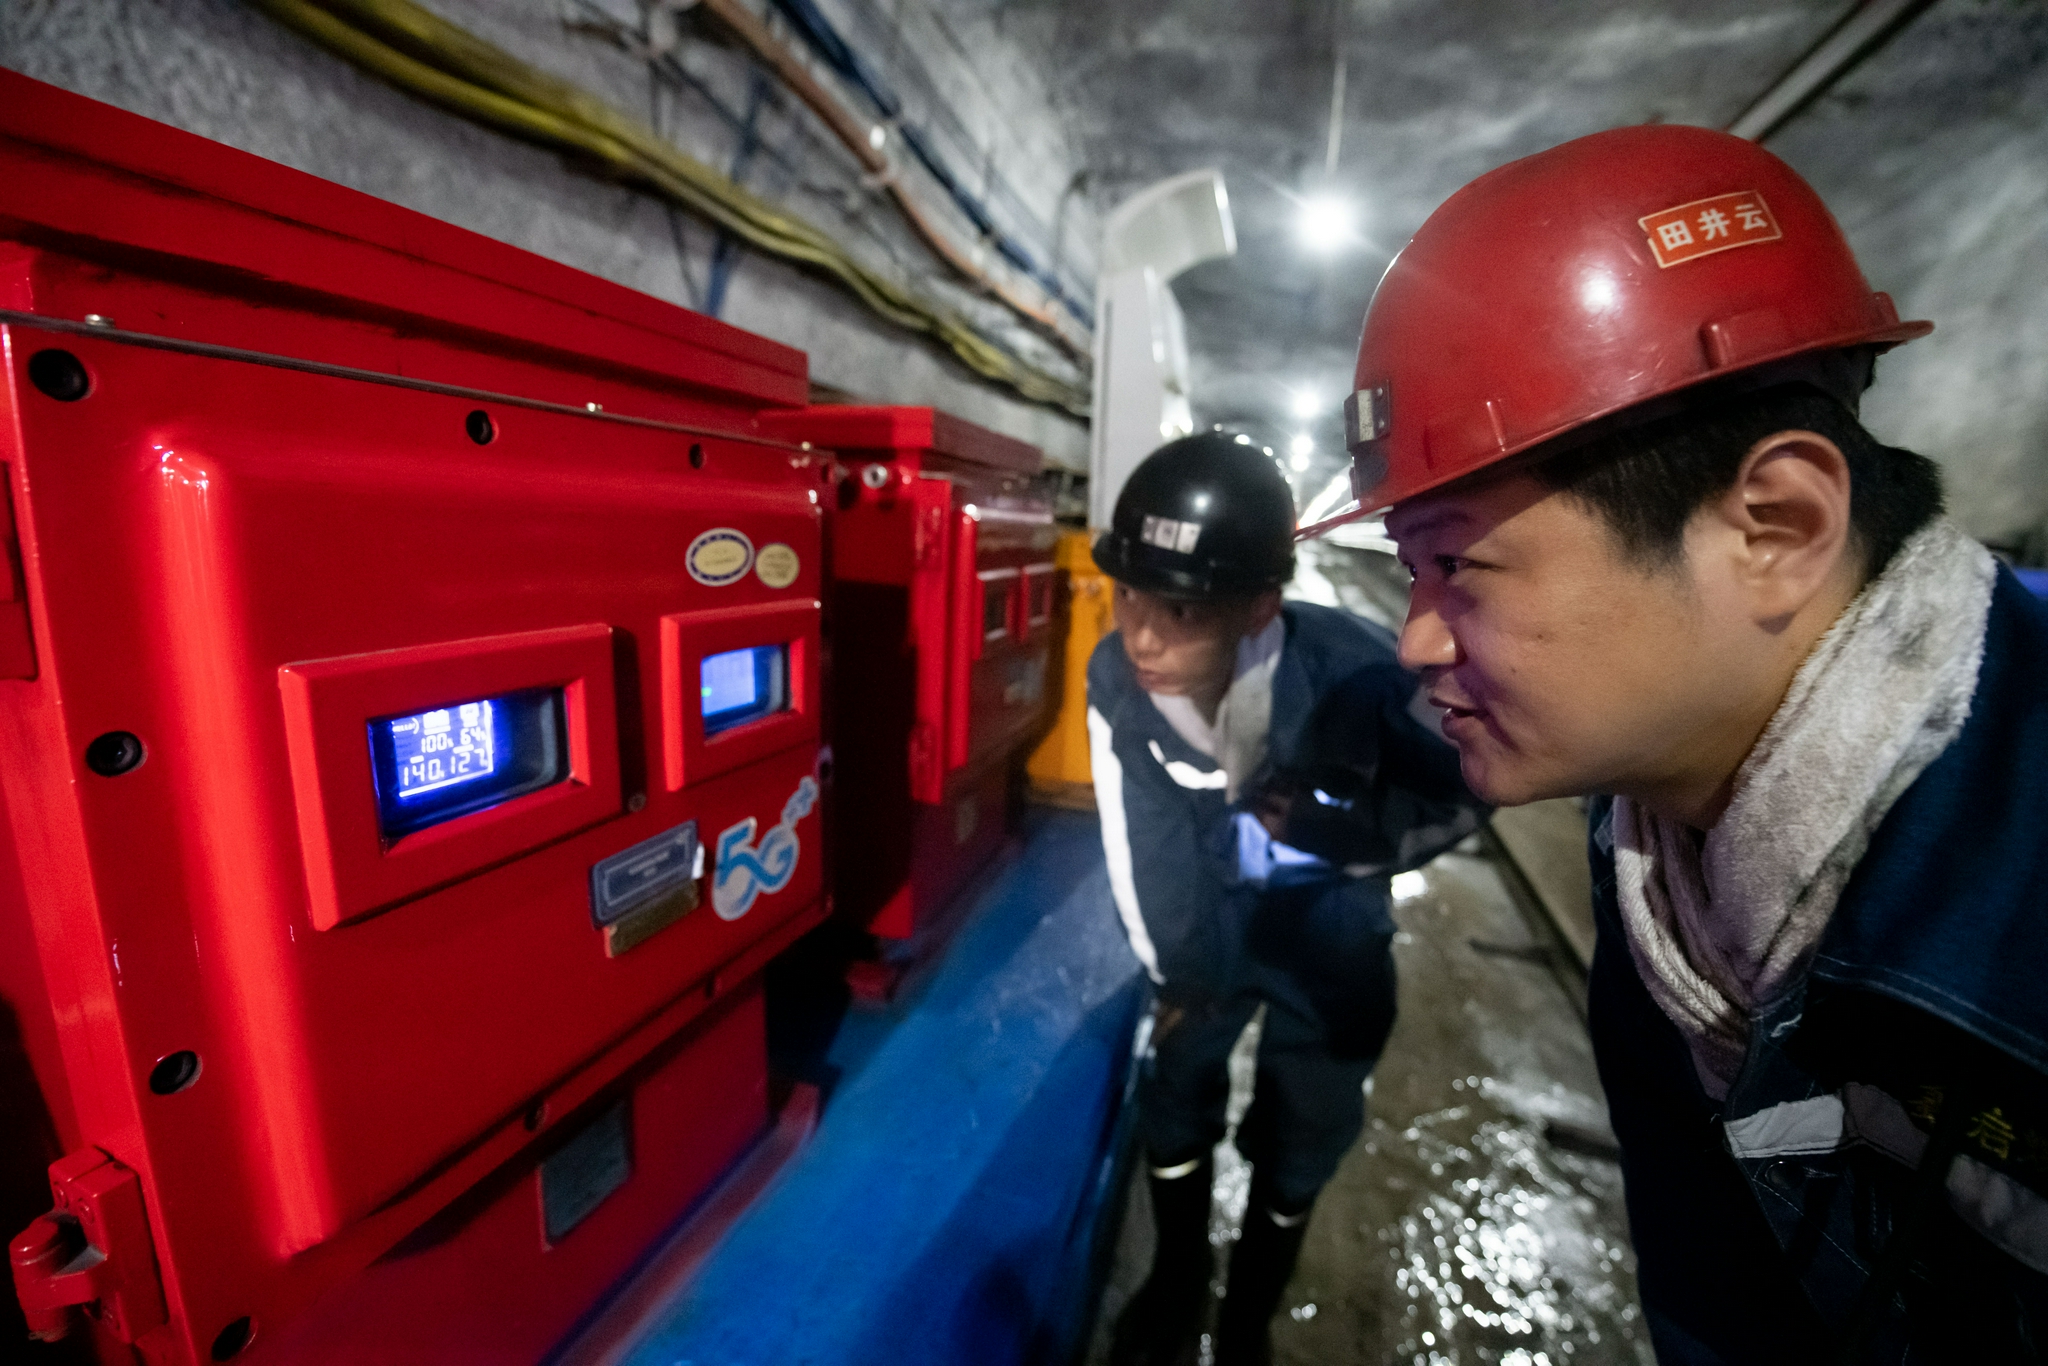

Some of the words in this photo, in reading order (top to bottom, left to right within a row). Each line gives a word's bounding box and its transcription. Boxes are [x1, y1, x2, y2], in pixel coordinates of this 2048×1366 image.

[1656, 203, 1768, 251] 田井云
[713, 817, 800, 921] 5G
